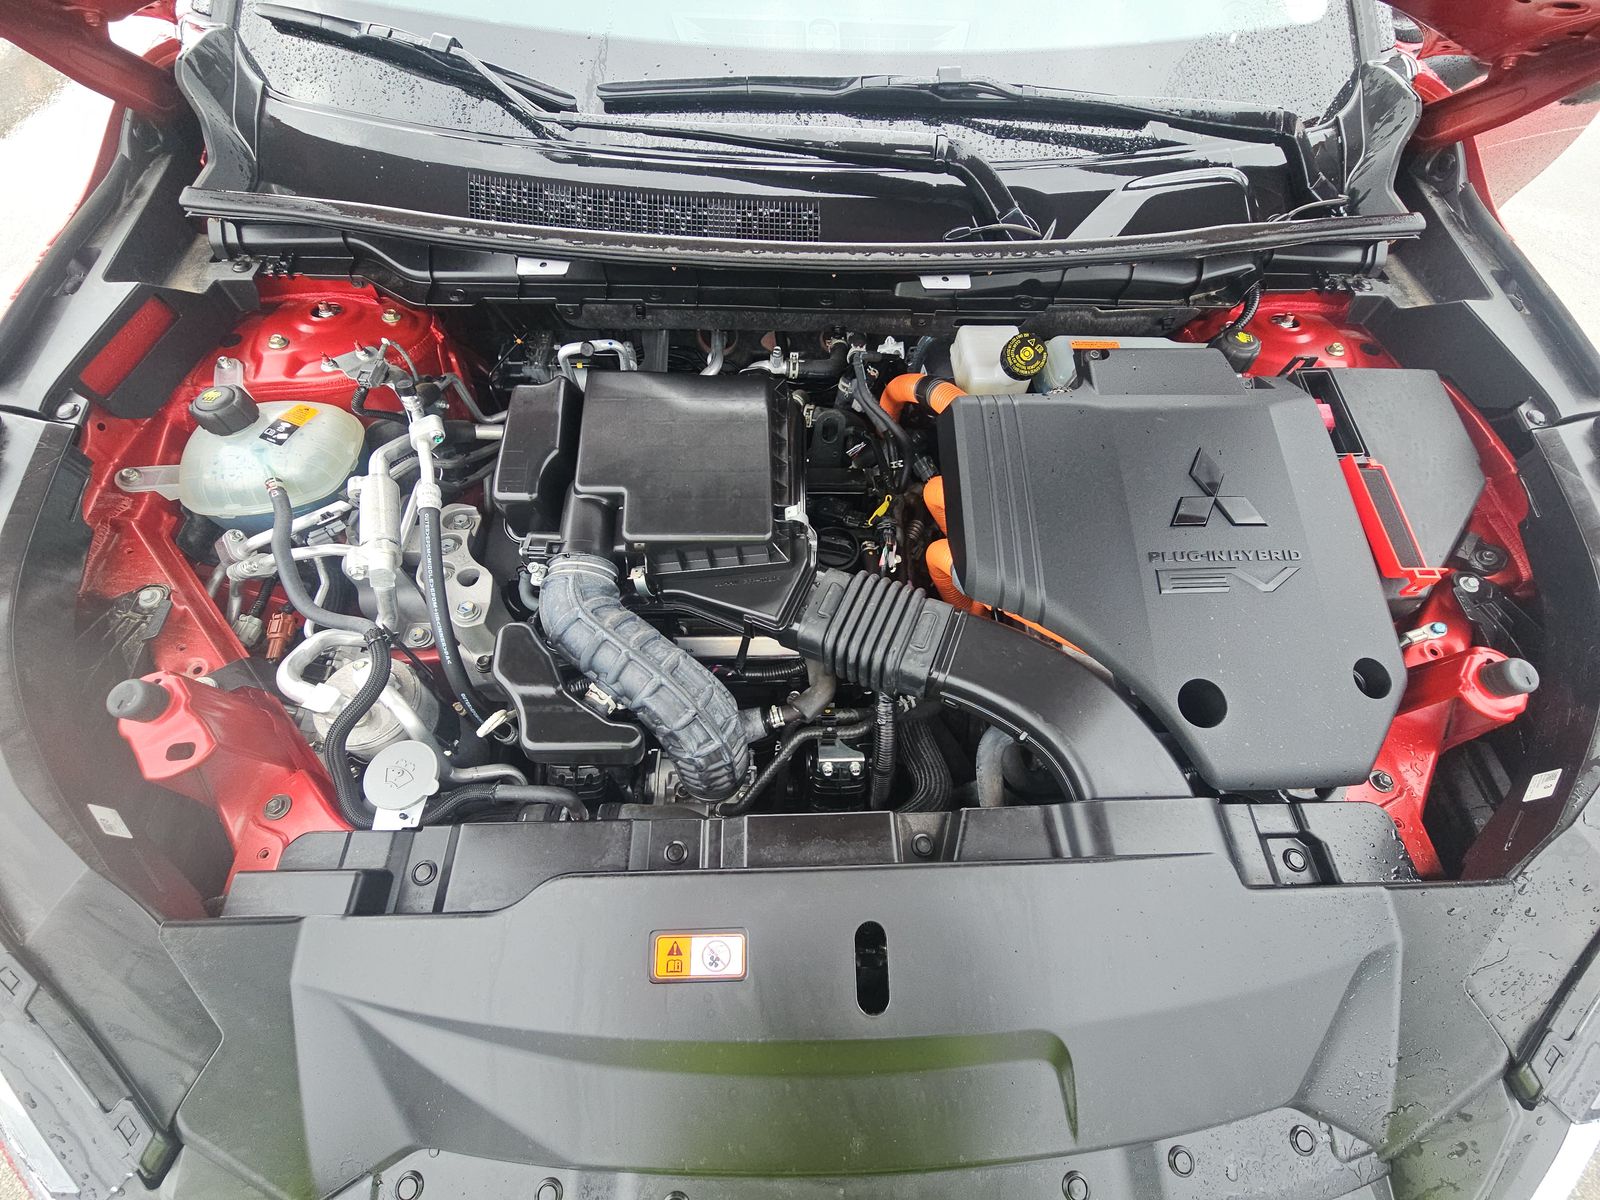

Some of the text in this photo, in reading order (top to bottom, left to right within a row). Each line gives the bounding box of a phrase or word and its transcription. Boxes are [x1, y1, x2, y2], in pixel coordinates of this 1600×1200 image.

[1148, 549, 1302, 563] PLUG-IN HYBRID
[1155, 566, 1302, 595] EV
